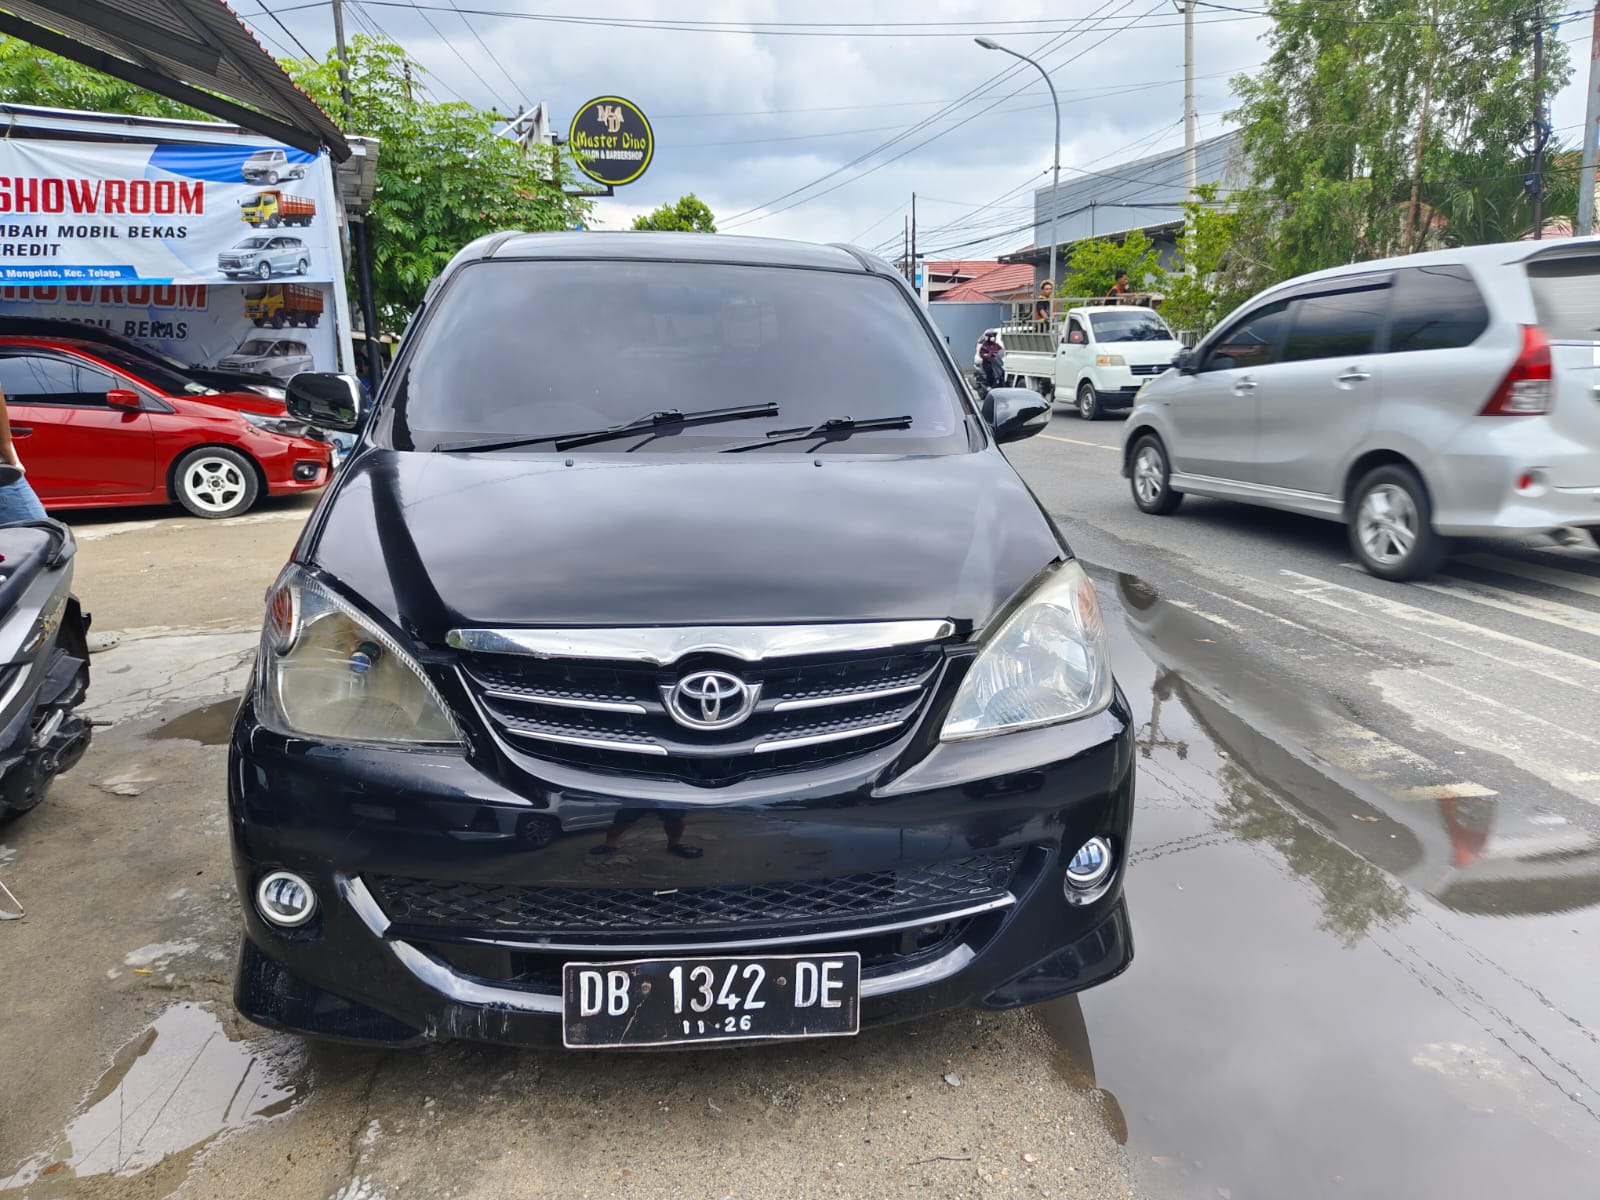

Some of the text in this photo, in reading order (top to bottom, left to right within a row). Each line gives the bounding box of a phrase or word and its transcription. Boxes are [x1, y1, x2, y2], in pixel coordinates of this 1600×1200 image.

[577, 131, 646, 149] Master Dino
[606, 150, 643, 161] BARBERSHOP
[58, 225, 119, 238] MOBIL
[128, 226, 187, 238] BEKAS
[0, 243, 61, 257] REDIT
[6, 269, 61, 279] Mongolato,
[64, 269, 86, 278] Kec.
[88, 269, 121, 279] Telaga
[580, 970, 630, 1017] DB
[669, 964, 766, 1014] 1342
[794, 961, 844, 1008] DE
